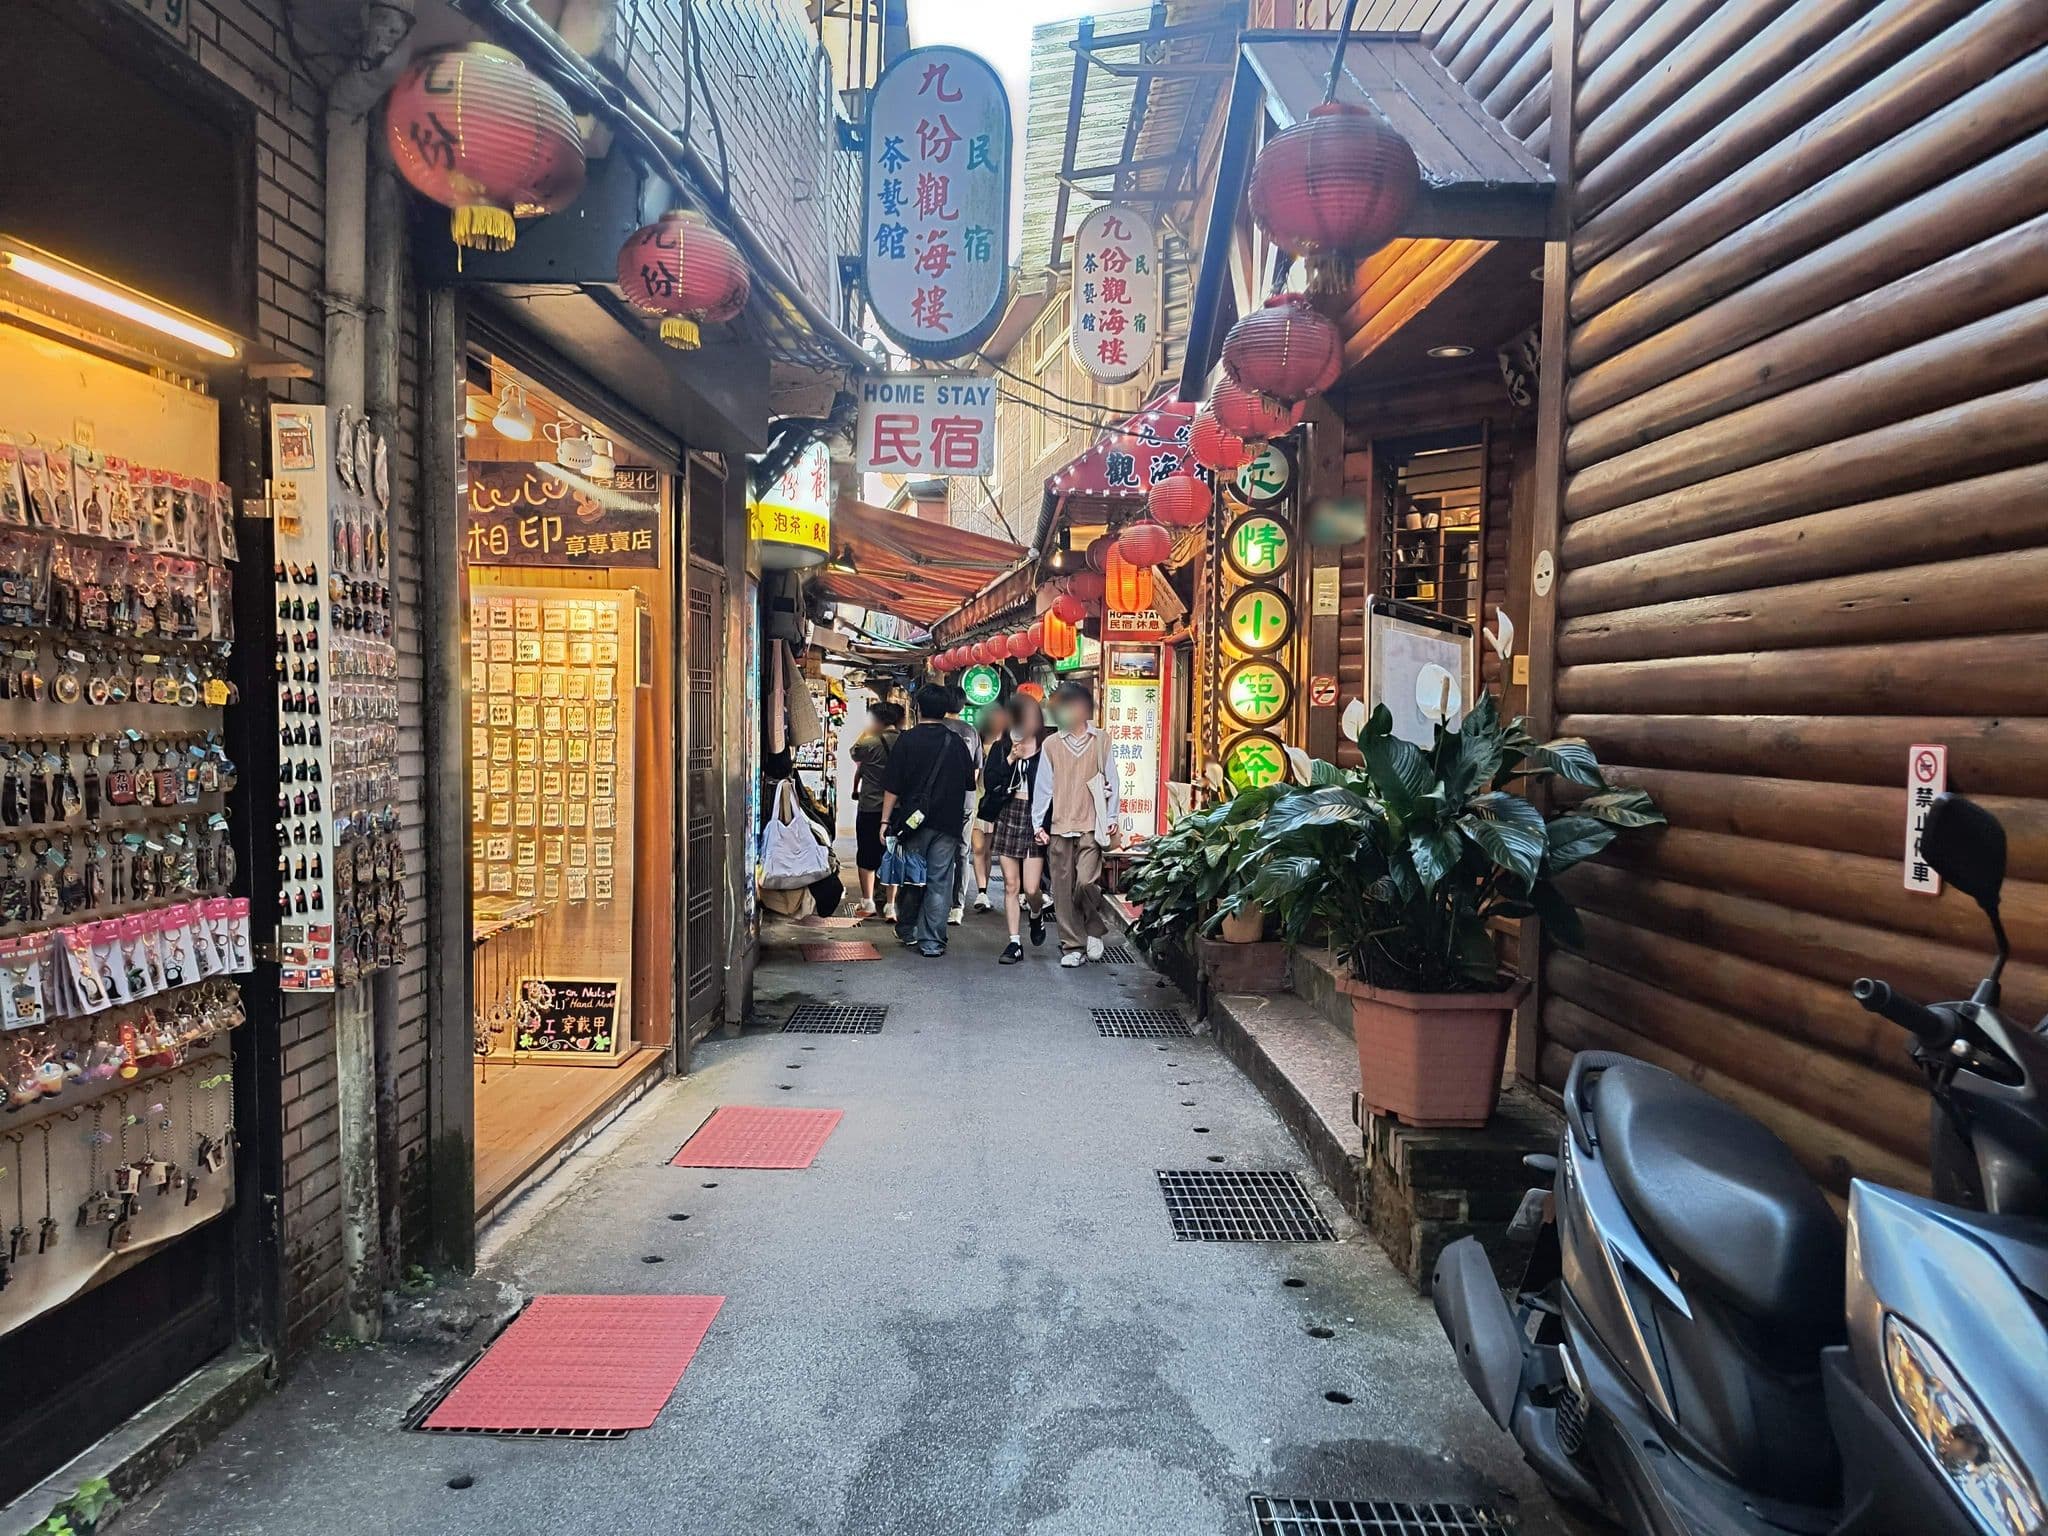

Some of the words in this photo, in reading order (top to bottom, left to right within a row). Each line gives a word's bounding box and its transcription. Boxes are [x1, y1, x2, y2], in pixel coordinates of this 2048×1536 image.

[873, 135, 911, 260] 茶藝館
[911, 63, 963, 333] 九份觀海樓
[963, 134, 998, 263] 民宿
[1081, 253, 1099, 332] 茶藝館
[1097, 215, 1132, 365] 九份觀海樓
[1133, 254, 1150, 334] 民宿
[863, 383, 926, 404] HOME
[936, 386, 990, 406] STAY
[868, 414, 983, 469] 民宿
[1106, 451, 1208, 487] 觀海
[467, 516, 563, 560] 相印
[564, 528, 652, 557] 章專賣店
[1109, 725, 1143, 741] 花果茶
